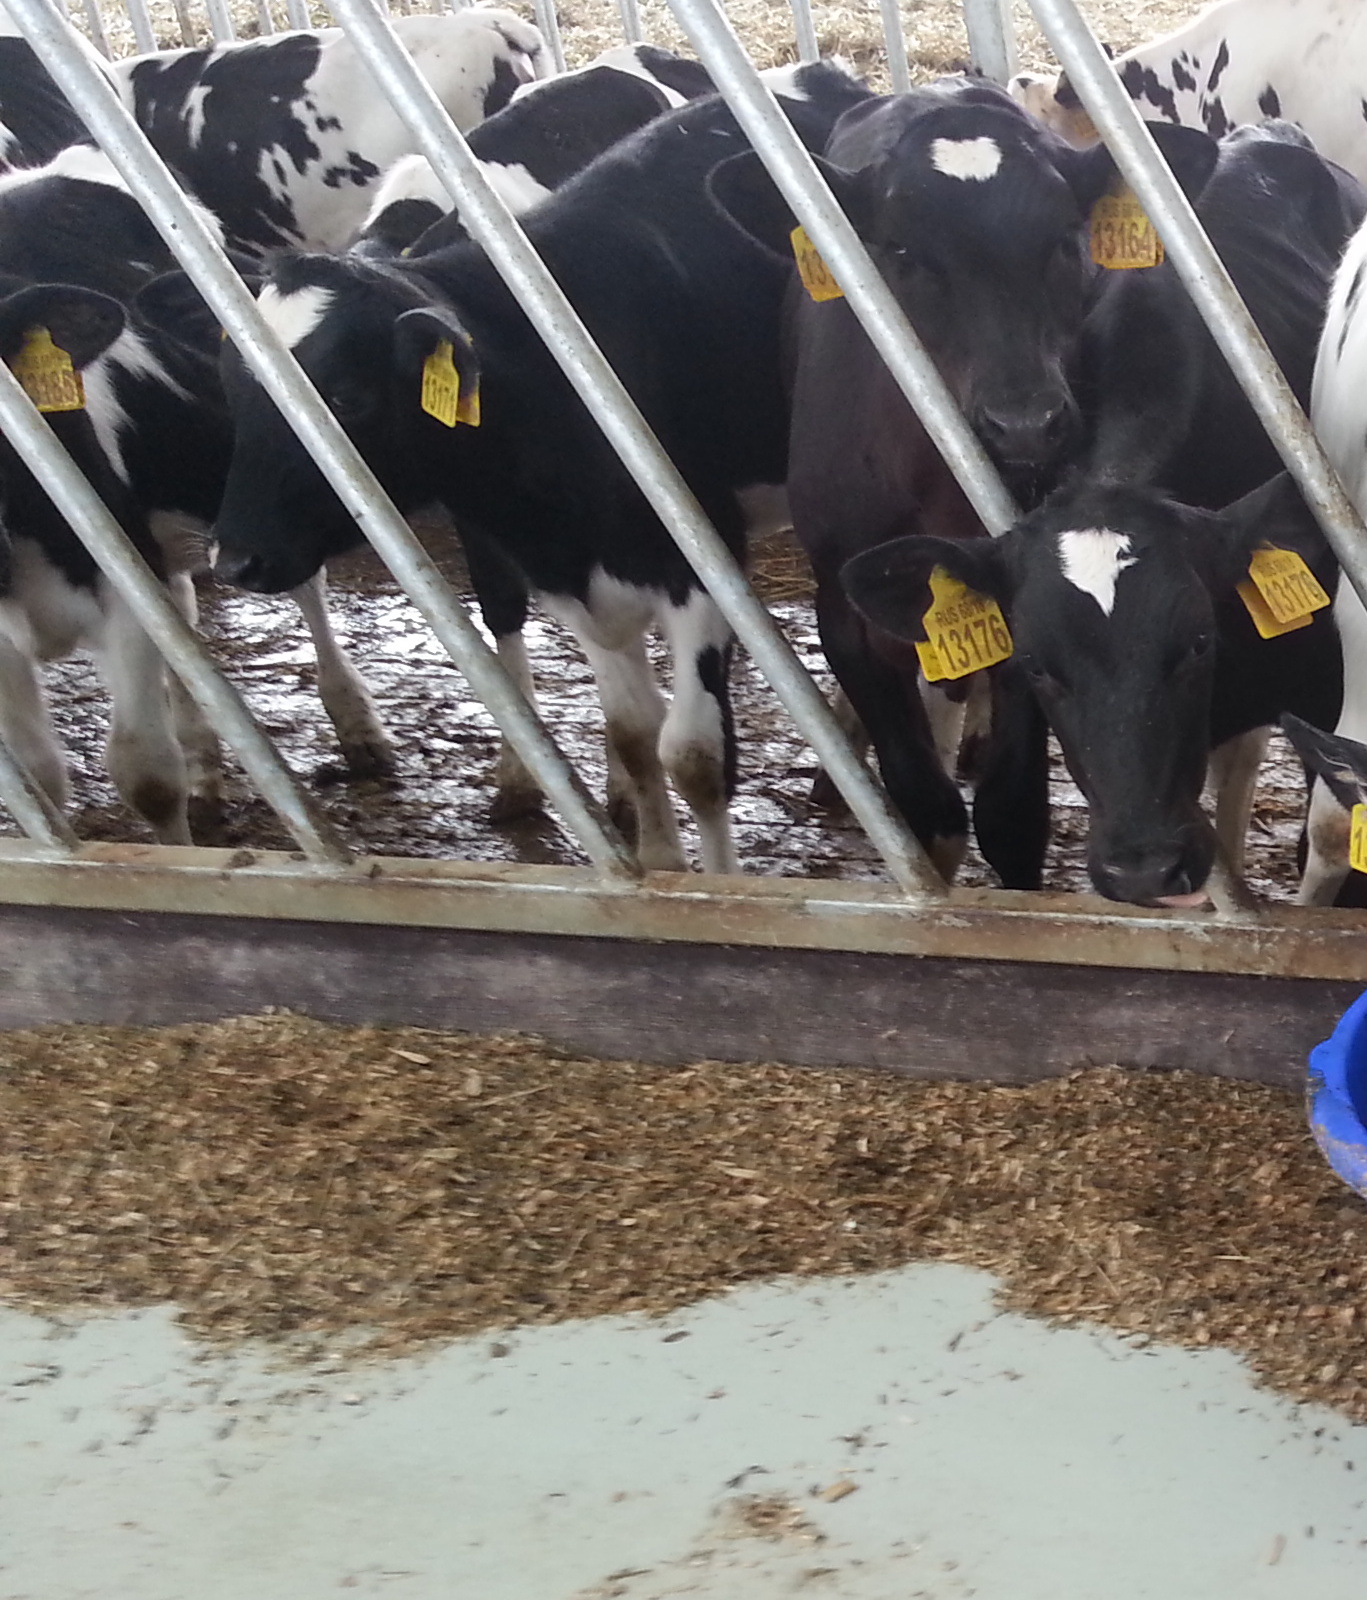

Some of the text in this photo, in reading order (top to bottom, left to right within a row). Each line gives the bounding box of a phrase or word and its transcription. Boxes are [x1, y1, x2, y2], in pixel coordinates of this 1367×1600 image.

[1095, 221, 1154, 259] 13164
[1264, 569, 1325, 617] 13176
[935, 605, 960, 628] RUS
[938, 613, 1010, 672] 13176
